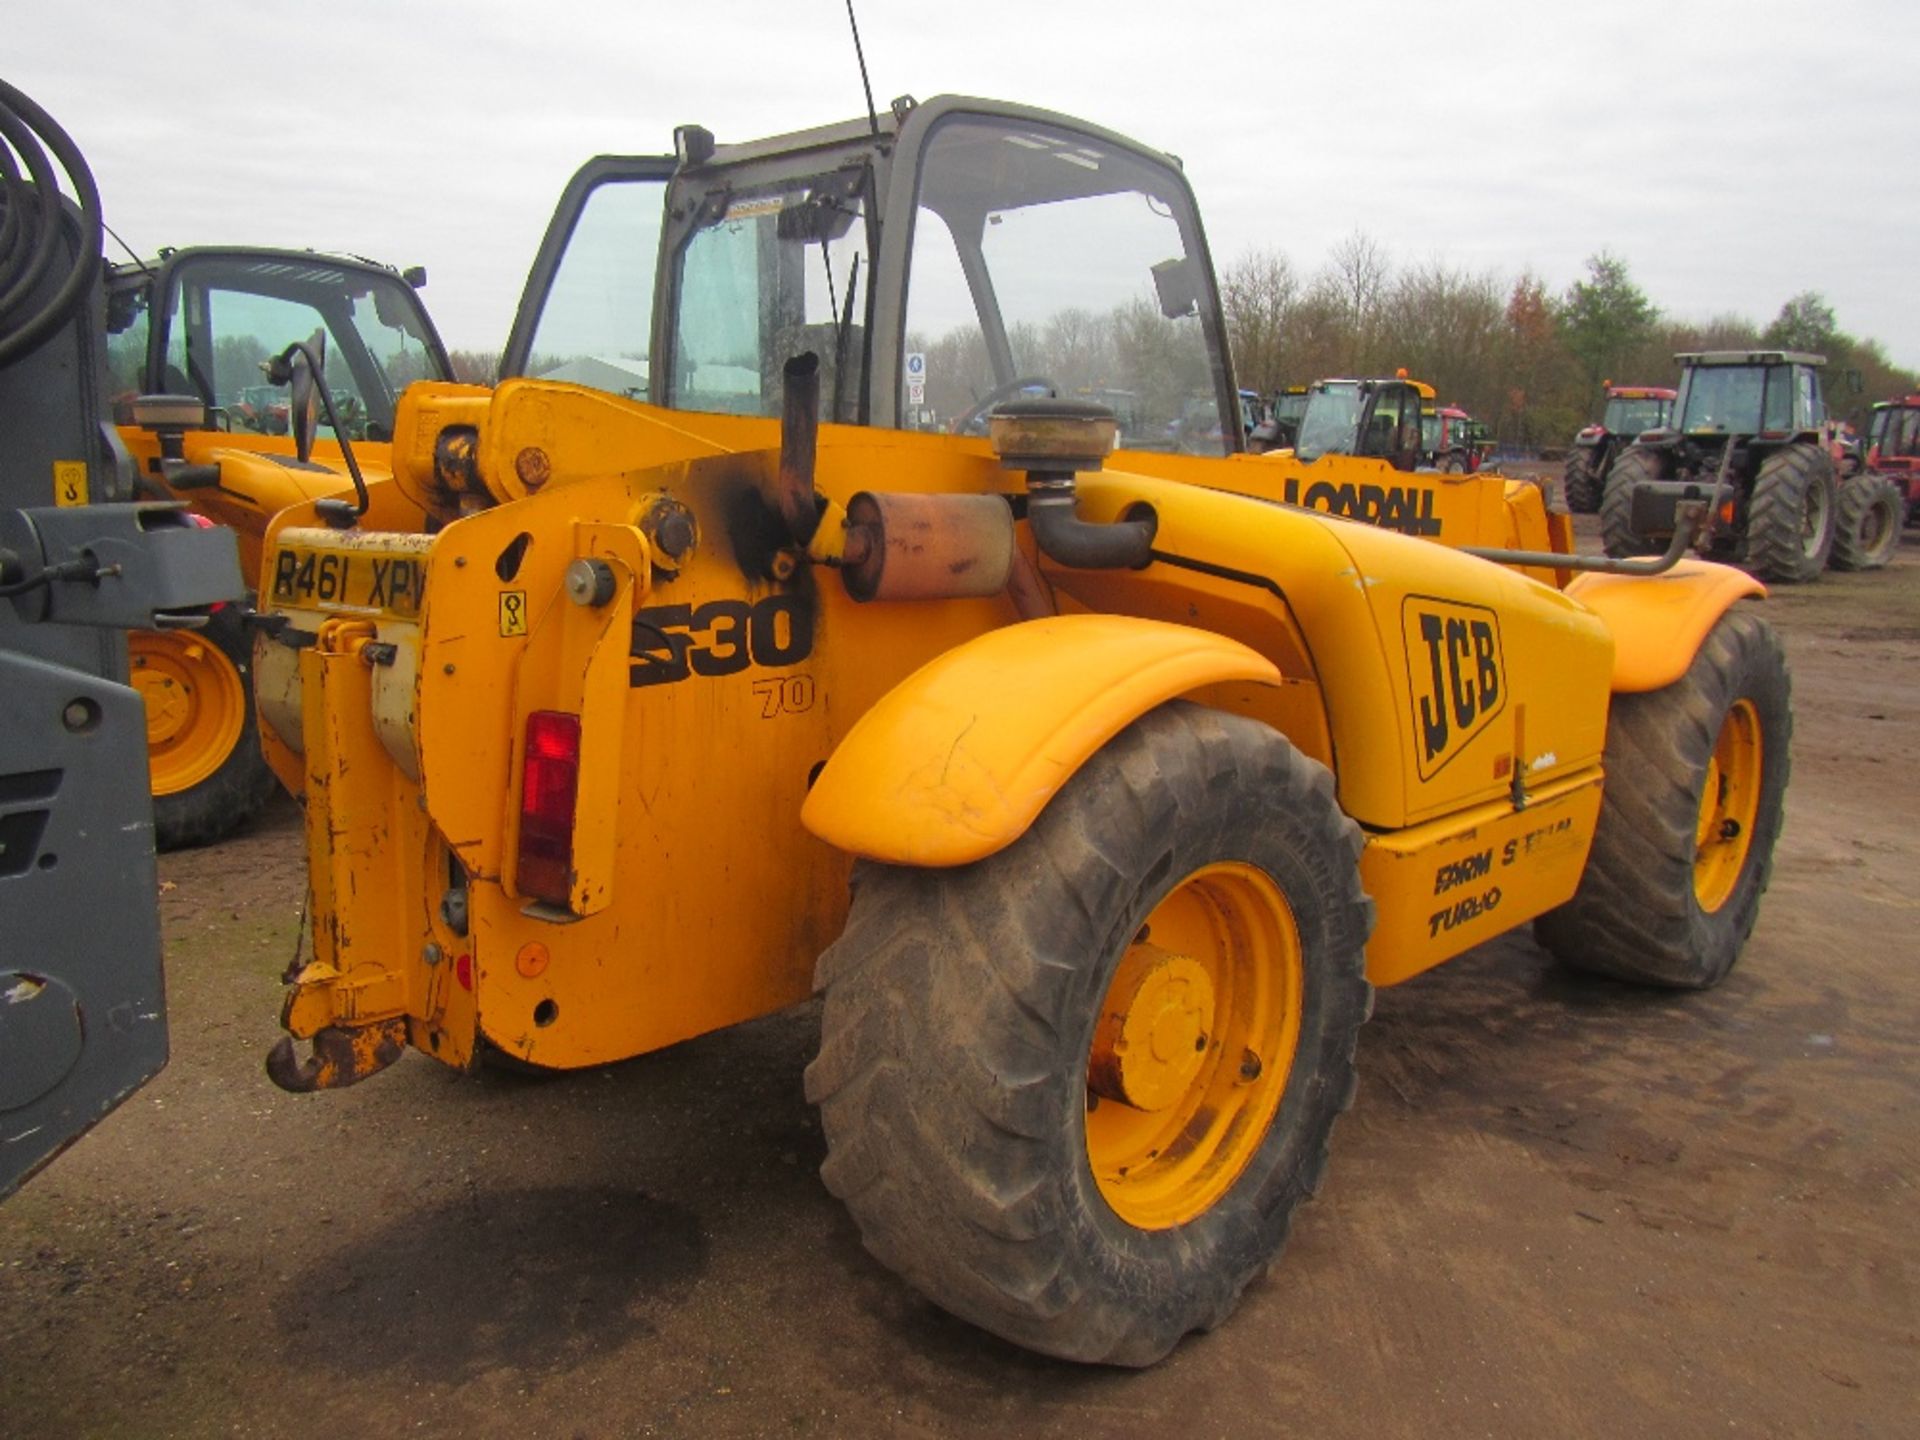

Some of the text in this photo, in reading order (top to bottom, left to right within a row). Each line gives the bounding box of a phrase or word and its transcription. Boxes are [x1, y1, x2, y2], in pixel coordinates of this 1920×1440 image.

[274, 550, 348, 602] R461
[629, 595, 815, 689] 530
[752, 674, 815, 719] 70
[1419, 612, 1499, 763] JCB
[1434, 847, 1493, 896] FARM
